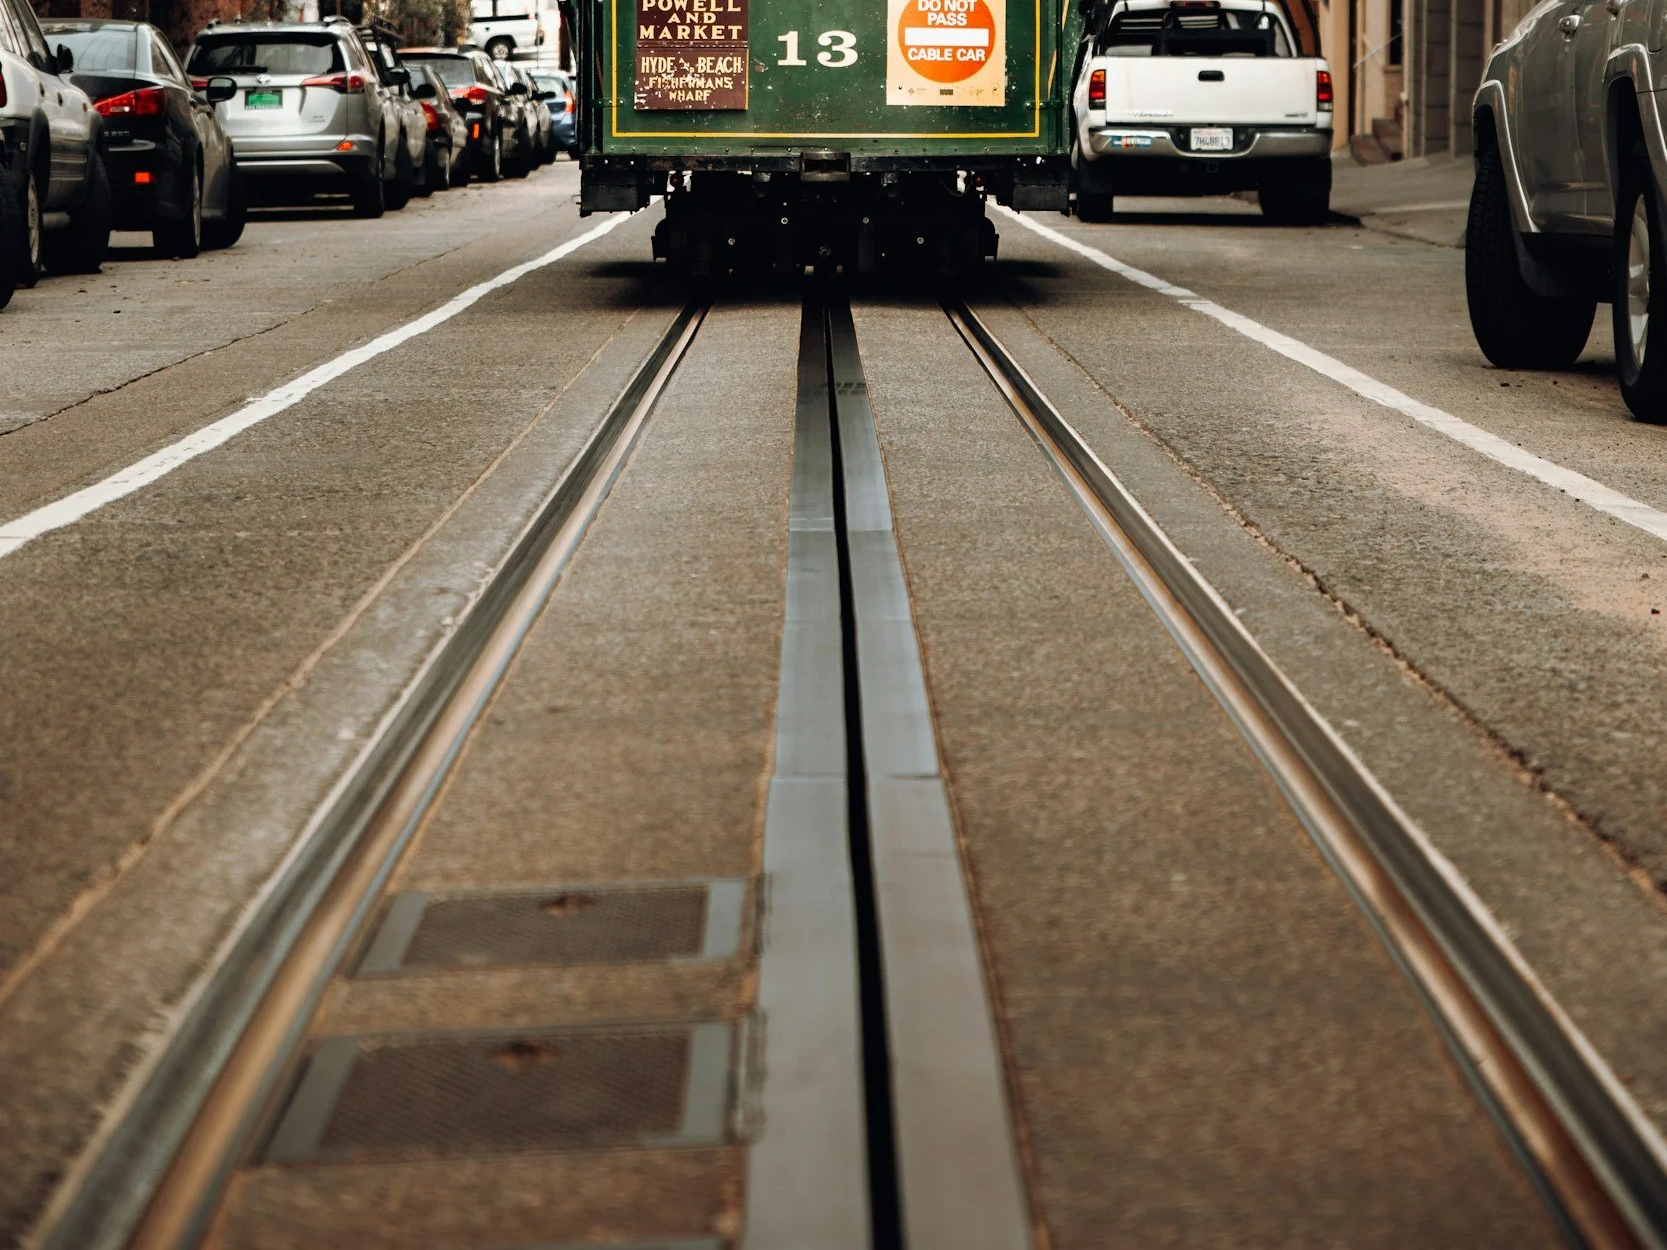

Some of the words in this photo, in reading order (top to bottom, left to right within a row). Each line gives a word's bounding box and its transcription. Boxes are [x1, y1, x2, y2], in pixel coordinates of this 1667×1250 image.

[667, 12, 717, 23] AND
[927, 12, 968, 26] PASS
[640, 25, 743, 39] MARKET
[777, 30, 858, 67] 13
[907, 48, 952, 61] CABLE
[957, 49, 985, 61] CAR
[641, 57, 676, 73] HYDE
[697, 56, 742, 73] BEACH
[669, 90, 712, 101] WHARF
